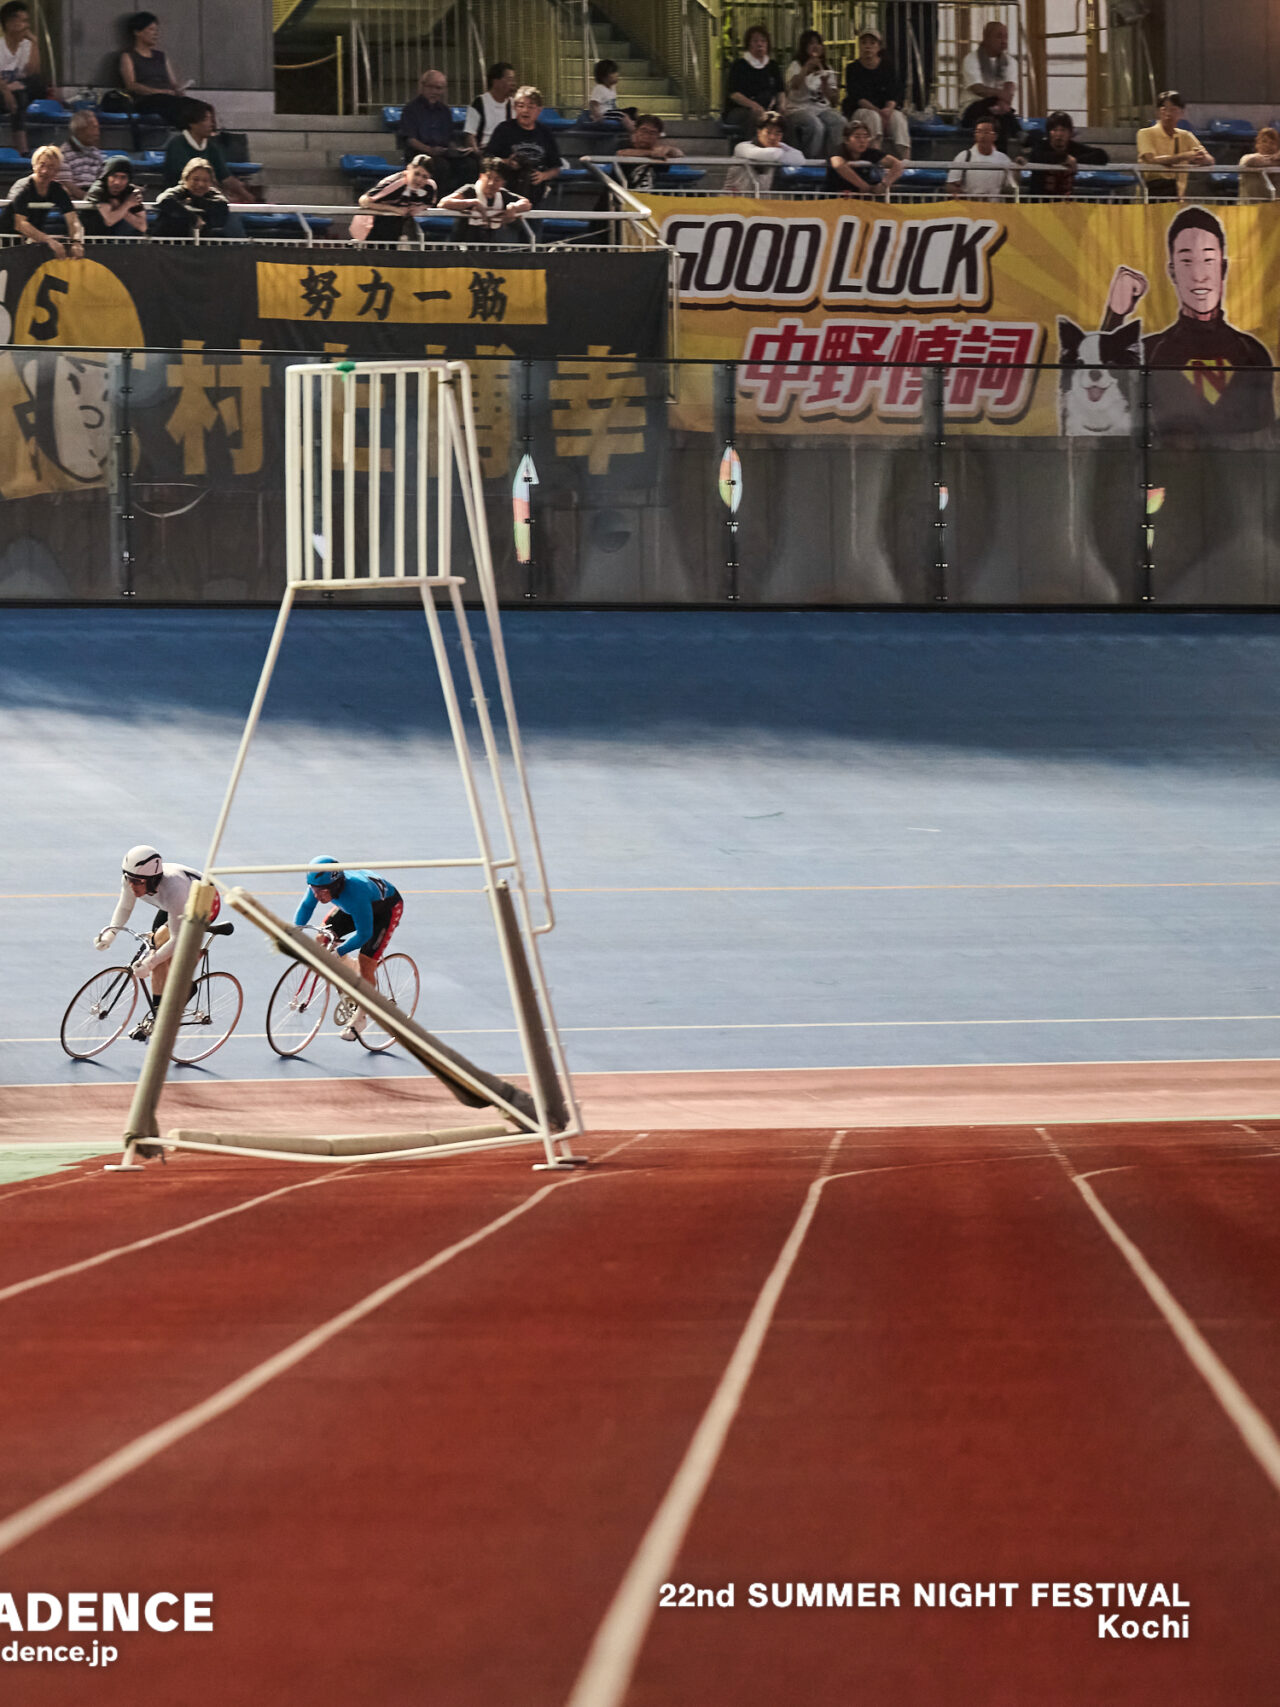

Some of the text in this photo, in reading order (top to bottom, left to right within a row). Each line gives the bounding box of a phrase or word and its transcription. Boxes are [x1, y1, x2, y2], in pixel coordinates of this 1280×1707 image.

[827, 220, 993, 295] LUCK
[28, 273, 69, 341] 5
[300, 266, 508, 322] 努力一筋
[741, 322, 1037, 407] 中野慎詞
